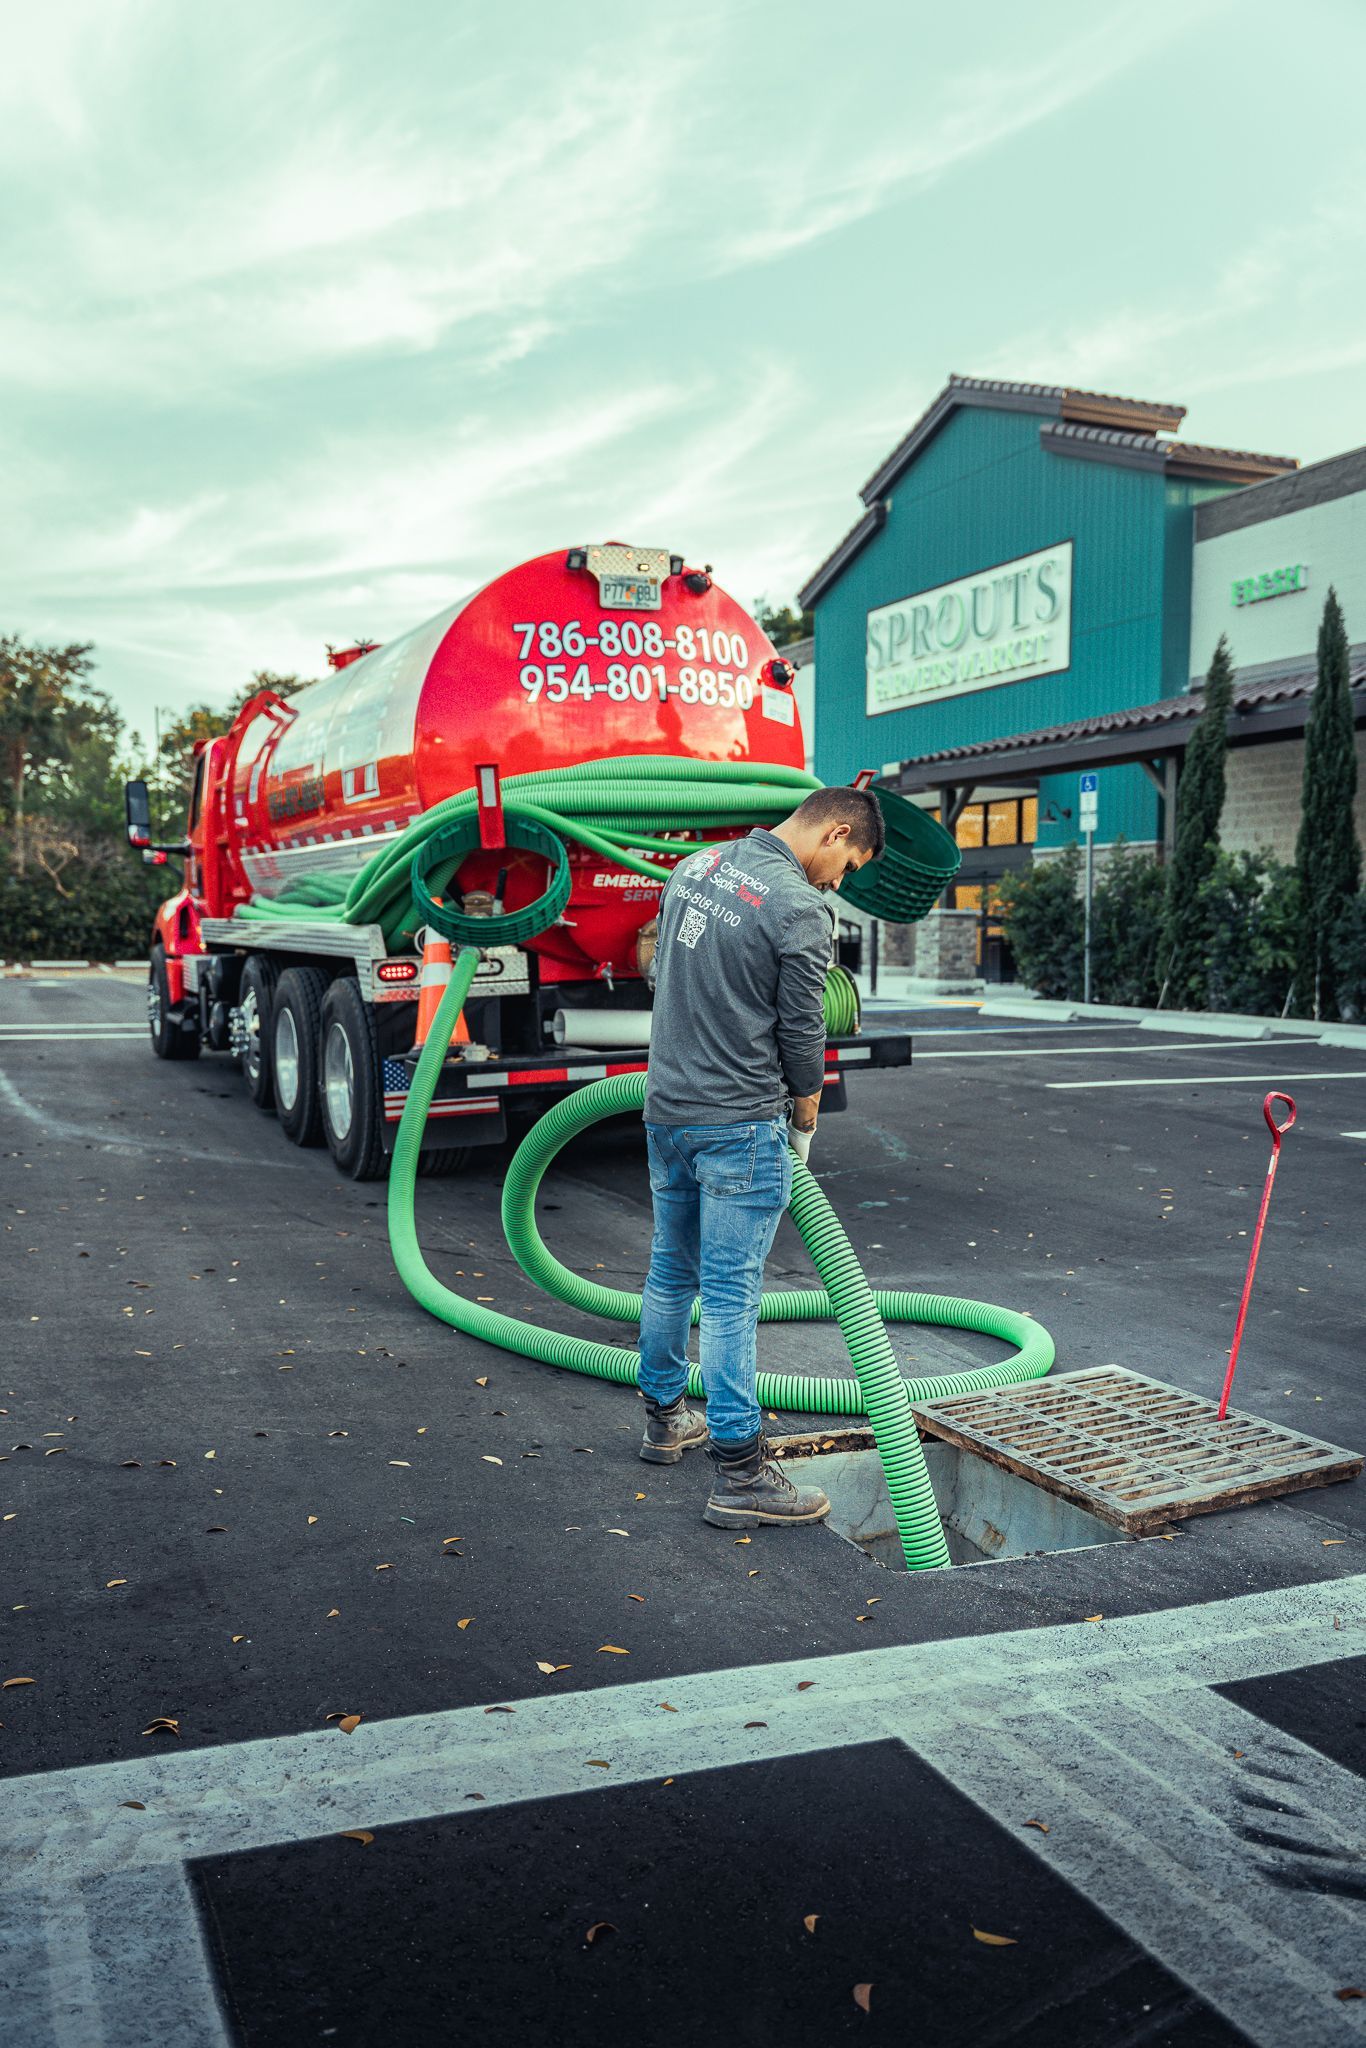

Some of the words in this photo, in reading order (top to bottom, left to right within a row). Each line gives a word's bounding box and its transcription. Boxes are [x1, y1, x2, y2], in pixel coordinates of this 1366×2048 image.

[1231, 563, 1309, 607] FRESH
[866, 560, 1057, 670] SPROUTS
[512, 620, 749, 669] 786-808-8100
[519, 663, 753, 710] 954-801-8850
[875, 661, 955, 701] FARMERS
[958, 636, 1050, 682] MARKET
[709, 872, 739, 894] Septic
[736, 884, 764, 910] Tank
[720, 861, 771, 896] Champion
[672, 884, 741, 927] 786-808-8100
[1014, 1454, 1048, 1469] USA
